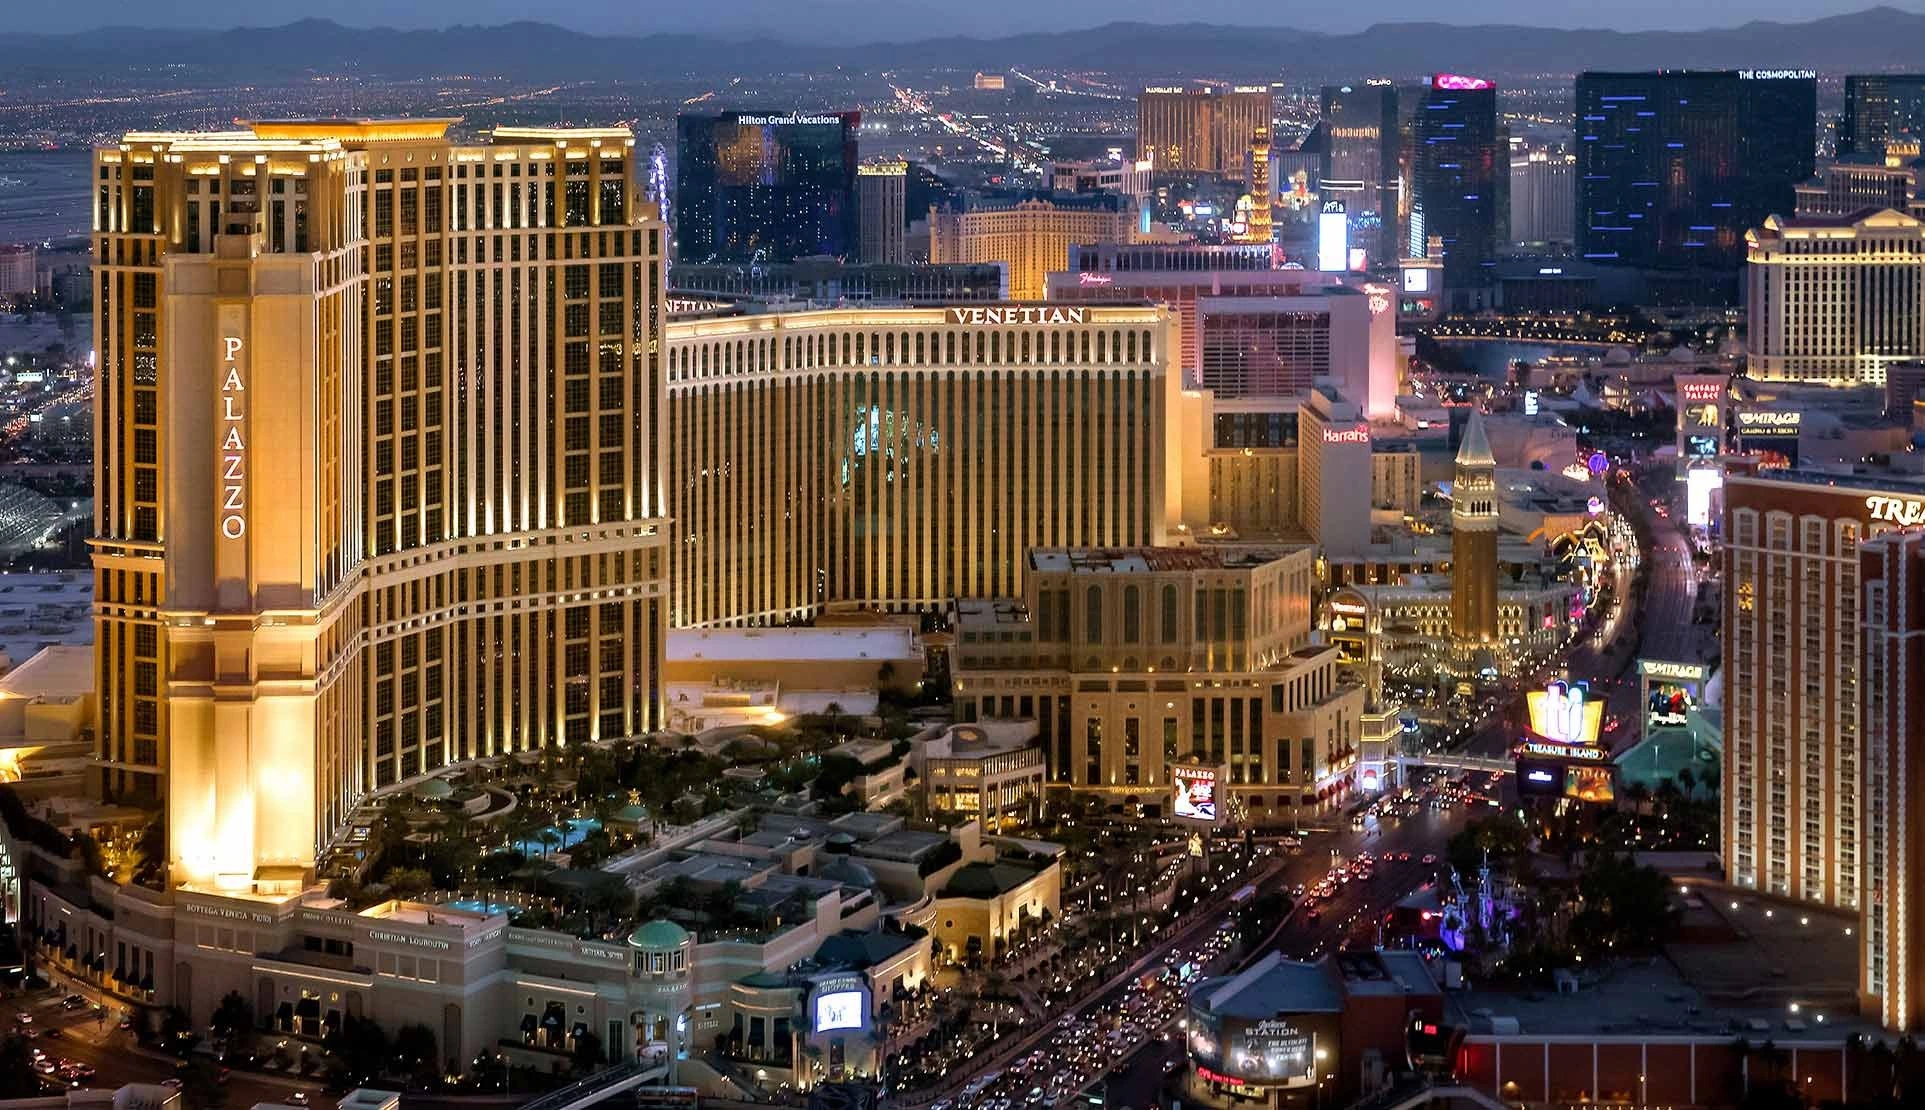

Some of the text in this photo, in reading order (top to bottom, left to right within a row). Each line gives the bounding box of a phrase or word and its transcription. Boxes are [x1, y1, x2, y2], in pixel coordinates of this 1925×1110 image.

[1738, 70, 1816, 80] THE COSMOPOLITAN
[738, 110, 840, 125] Hilton Grand Vacations
[952, 307, 1085, 325] VENETIAN
[1684, 384, 1721, 392] CAESARS
[1685, 391, 1719, 399] PALACE
[222, 336, 246, 539] PALAZZO
[1865, 496, 1925, 526] TRE
[1528, 743, 1600, 759] TREASURE ISLAND
[1175, 768, 1216, 780] PALAZZO
[1246, 1027, 1298, 1037] STATION
